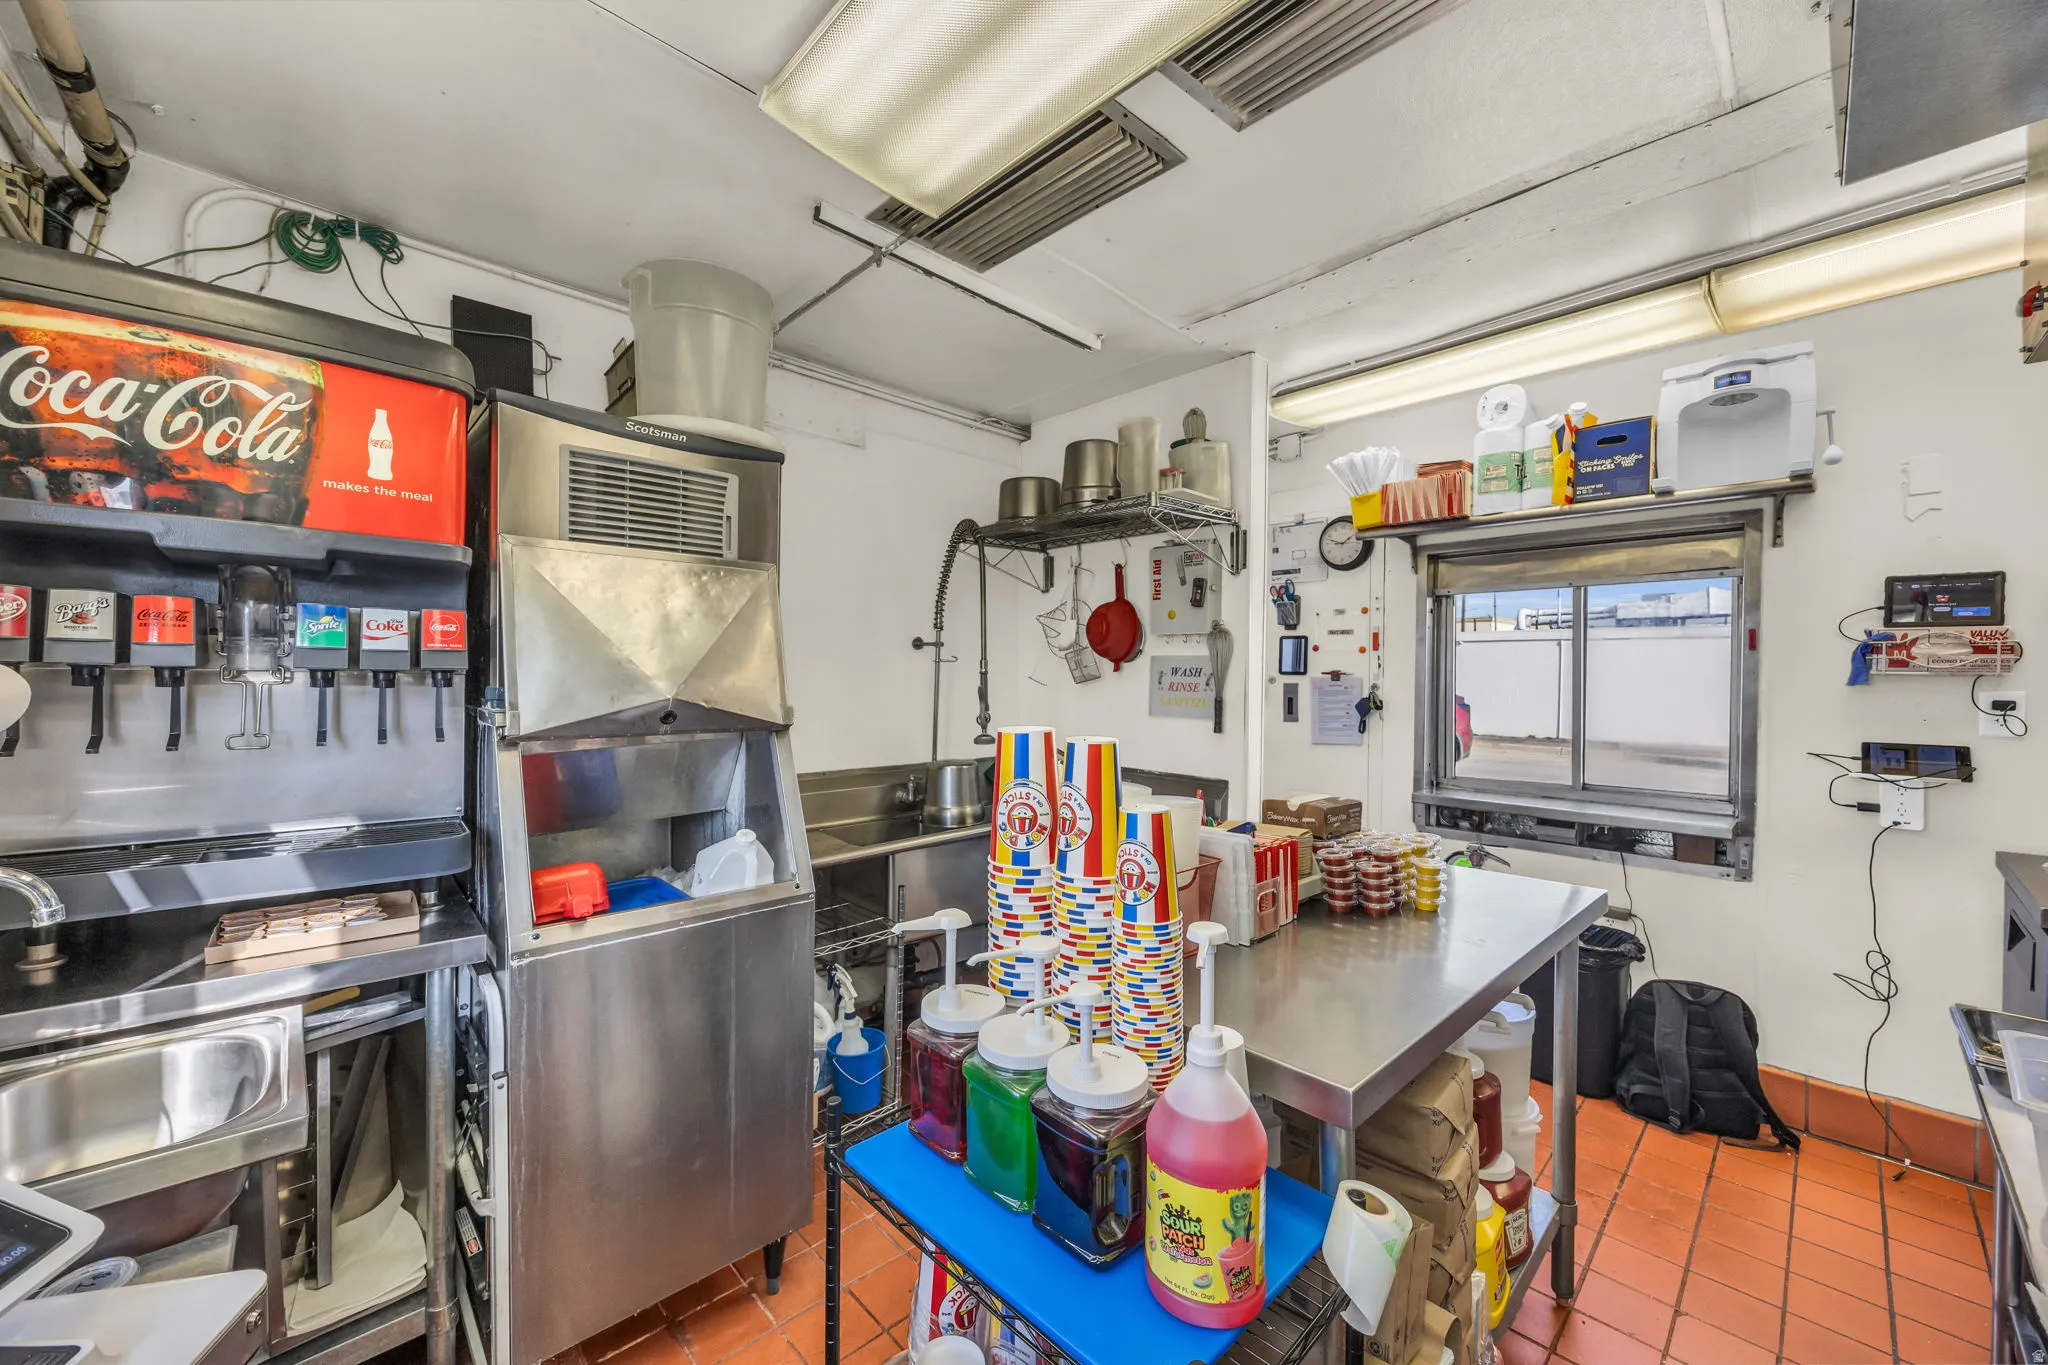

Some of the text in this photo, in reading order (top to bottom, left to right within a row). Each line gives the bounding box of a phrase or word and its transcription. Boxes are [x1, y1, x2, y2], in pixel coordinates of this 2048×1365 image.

[0, 345, 312, 464] Coca-Cola
[625, 421, 687, 442] Scotsman
[1593, 463, 1615, 471] FACES
[323, 480, 433, 502] makes the meal
[1153, 560, 1162, 600] First Aid
[306, 619, 340, 633] Sprite
[366, 619, 404, 631] Coke
[1970, 630, 1997, 638] VALU
[1171, 667, 1203, 677] WASH
[1168, 682, 1200, 692] RINSE
[1003, 791, 1031, 808] STICK
[998, 822, 1048, 846] HOT DOG
[1064, 827, 1088, 849] HOT
[1133, 881, 1157, 903] HOT
[1162, 1210, 1201, 1236] SOUR
[1161, 1224, 1205, 1250] PATCH
[1231, 1270, 1251, 1285] SOUR
[1201, 1293, 1215, 1301] (2qt)
